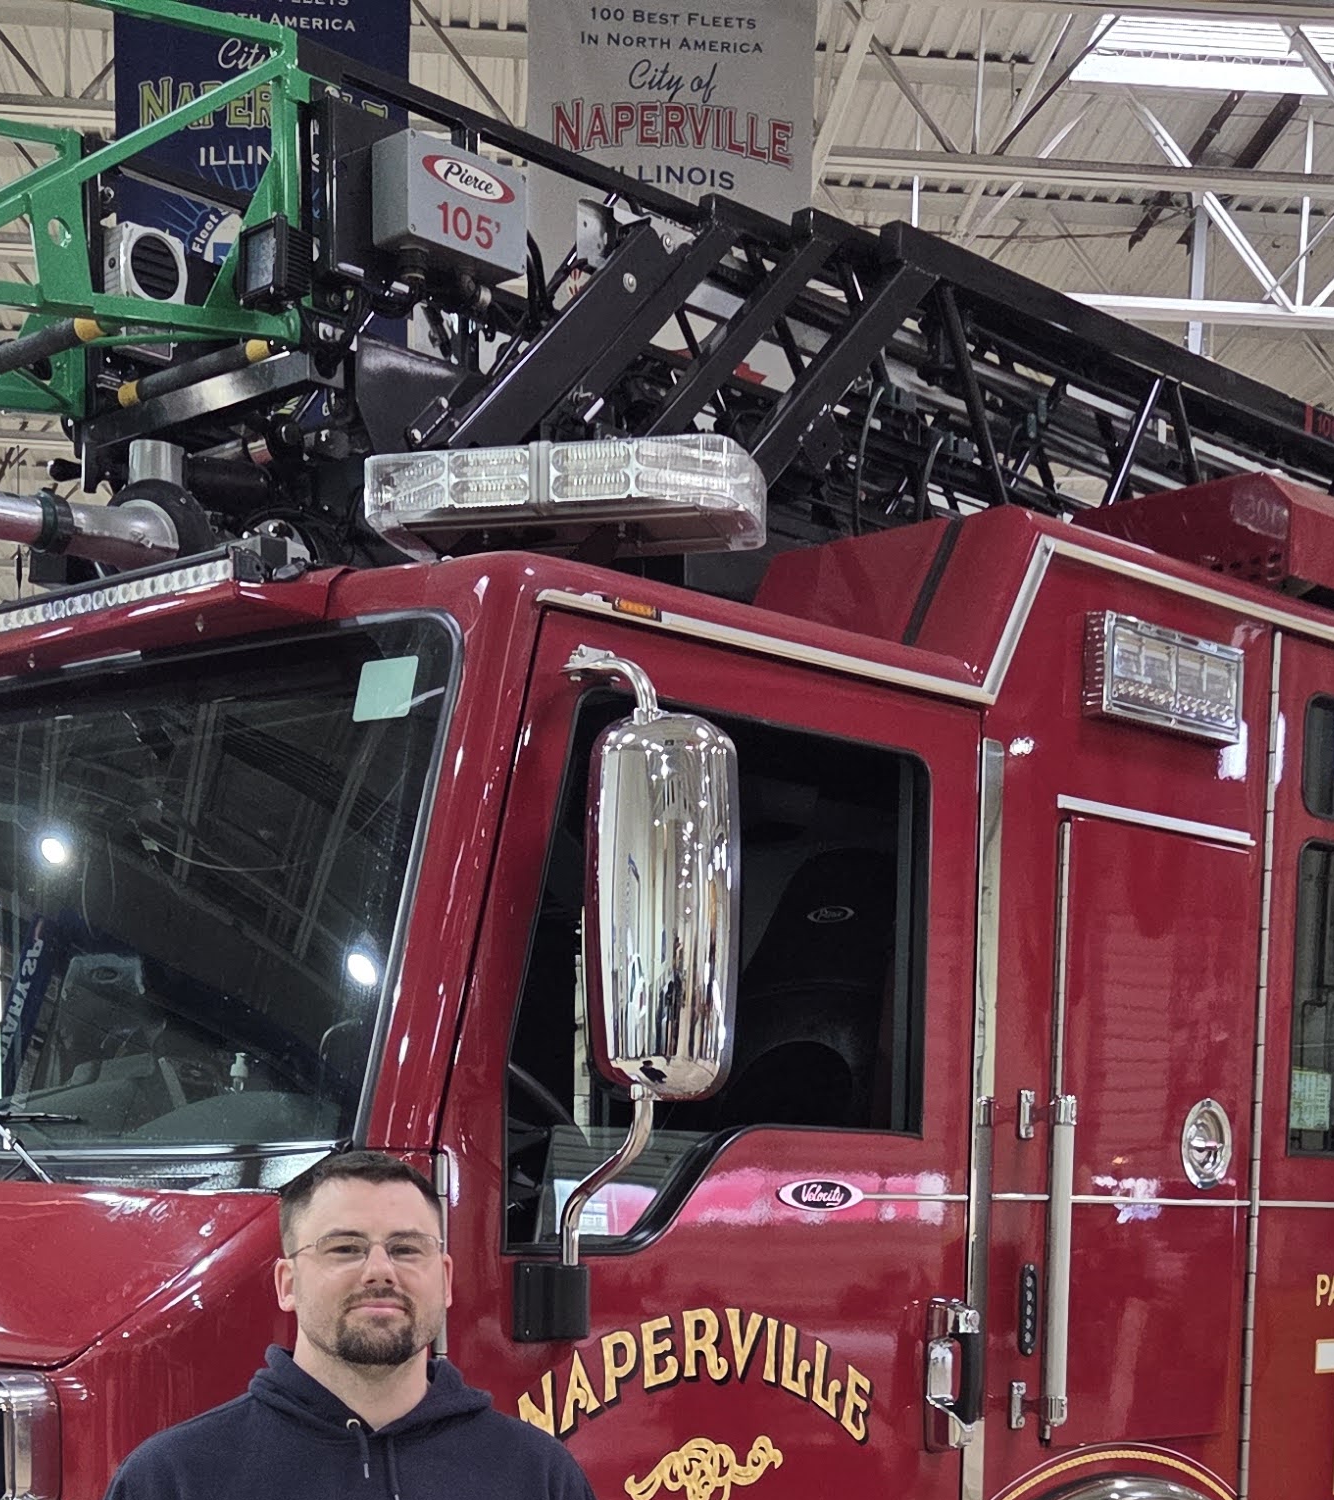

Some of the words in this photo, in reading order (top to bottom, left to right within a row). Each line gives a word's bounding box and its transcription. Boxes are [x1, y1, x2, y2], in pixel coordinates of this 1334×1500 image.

[268, 11, 357, 33] AMERICA
[590, 6, 625, 22] 100
[632, 9, 680, 26] BEST
[687, 12, 757, 30] FLEETS
[580, 31, 599, 46] IN
[606, 32, 671, 50] NORTH
[678, 36, 764, 54] AMERICA
[628, 58, 684, 103] City
[690, 62, 718, 104] of
[551, 96, 795, 169] NAPERVILLE
[199, 145, 273, 167] ILLIN
[443, 161, 492, 195] Pierce
[610, 164, 735, 191] LINOIS
[801, 1184, 844, 1207] Velocity
[517, 1307, 872, 1442] NAPERVILLE
